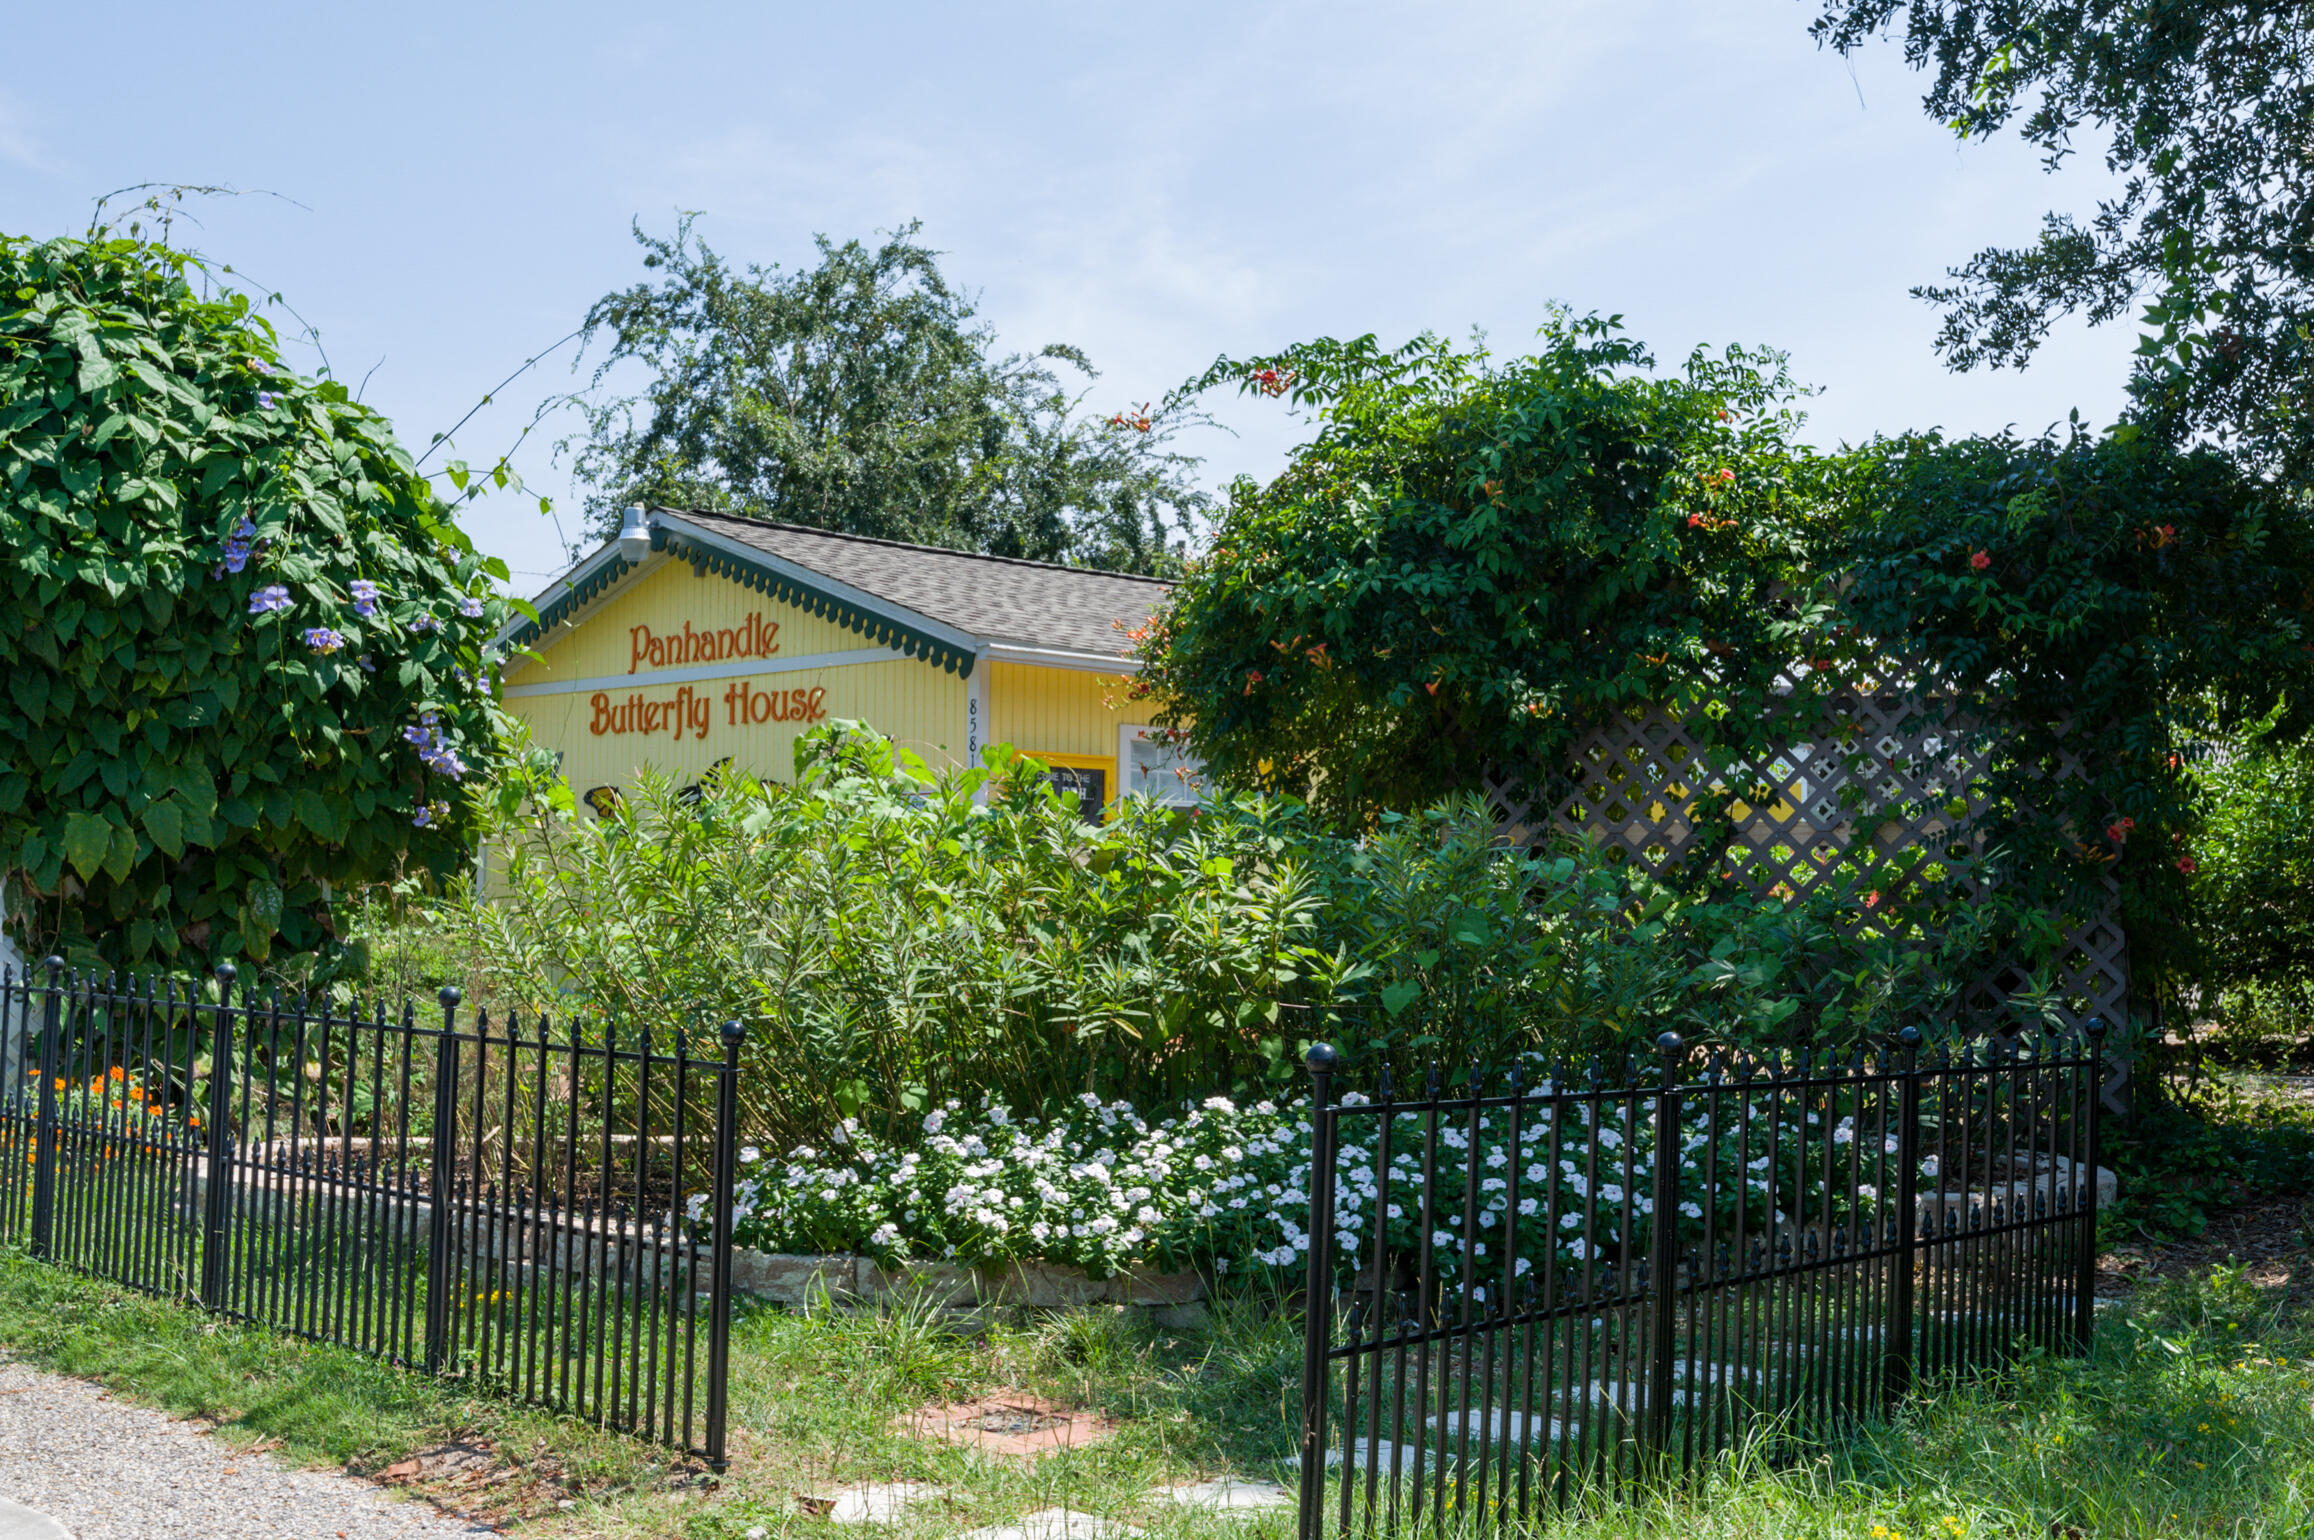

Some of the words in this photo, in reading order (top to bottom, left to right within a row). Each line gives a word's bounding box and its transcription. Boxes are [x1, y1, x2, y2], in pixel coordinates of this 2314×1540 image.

[628, 612, 780, 675] Panhandle
[590, 686, 710, 740] Butterfly
[724, 681, 827, 725] House
[969, 698, 977, 769] 8581
